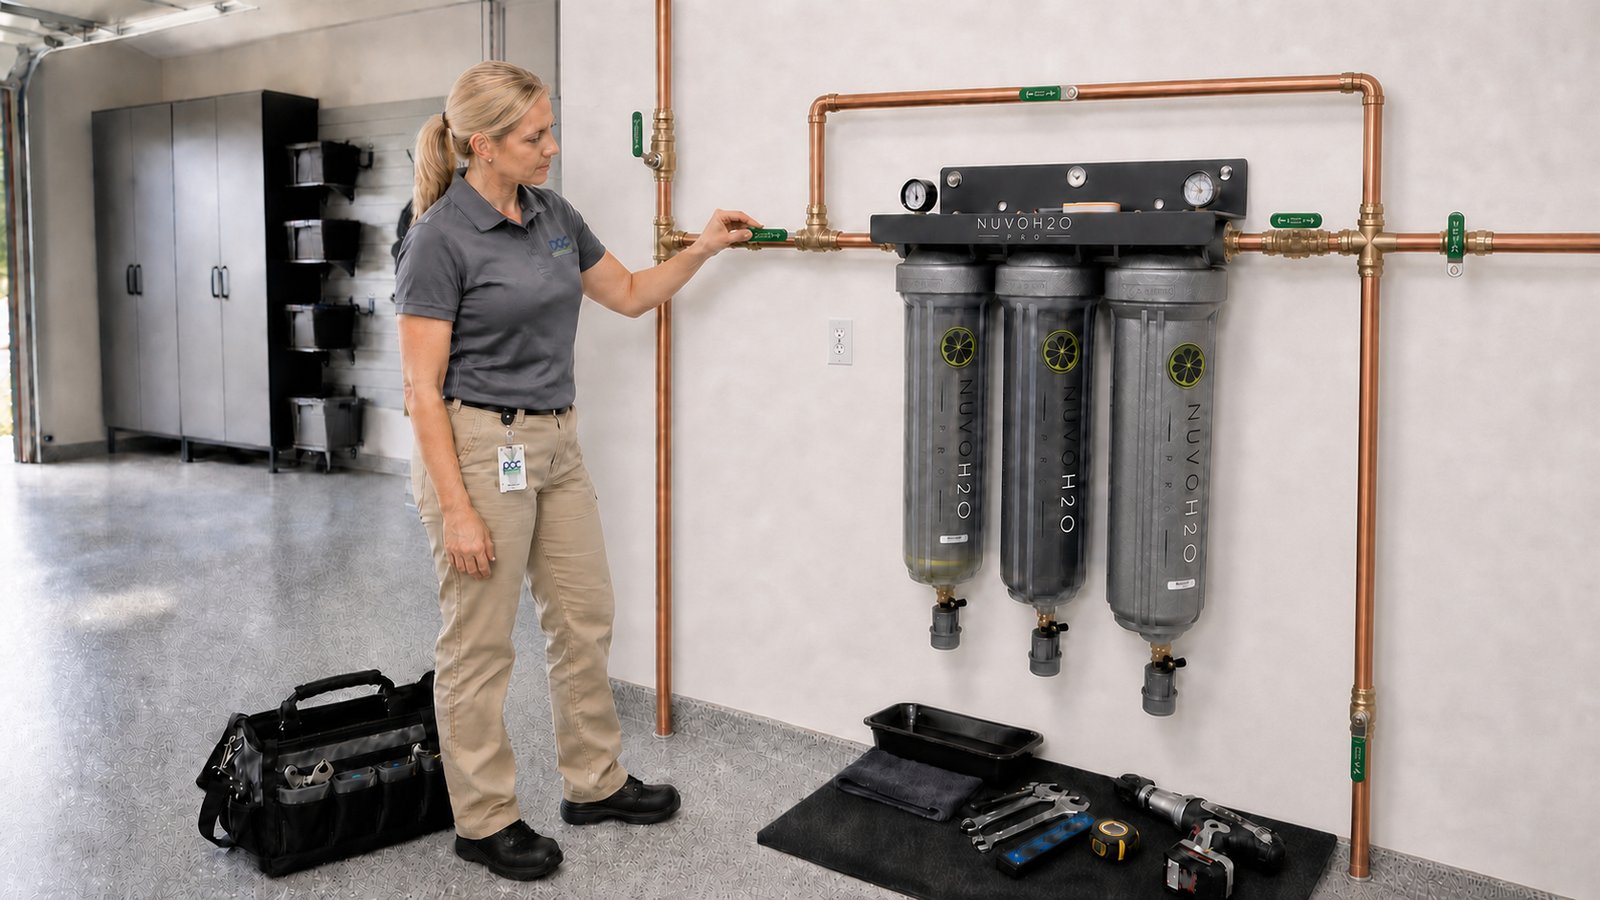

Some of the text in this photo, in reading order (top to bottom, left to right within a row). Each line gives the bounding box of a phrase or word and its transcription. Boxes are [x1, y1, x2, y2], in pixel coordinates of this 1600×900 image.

[977, 217, 1072, 230] NUVOH2O
[957, 379, 973, 519] NUVOH2O
[1060, 386, 1077, 533] NUVOH2O
[1183, 403, 1201, 563] NUVOH2O
